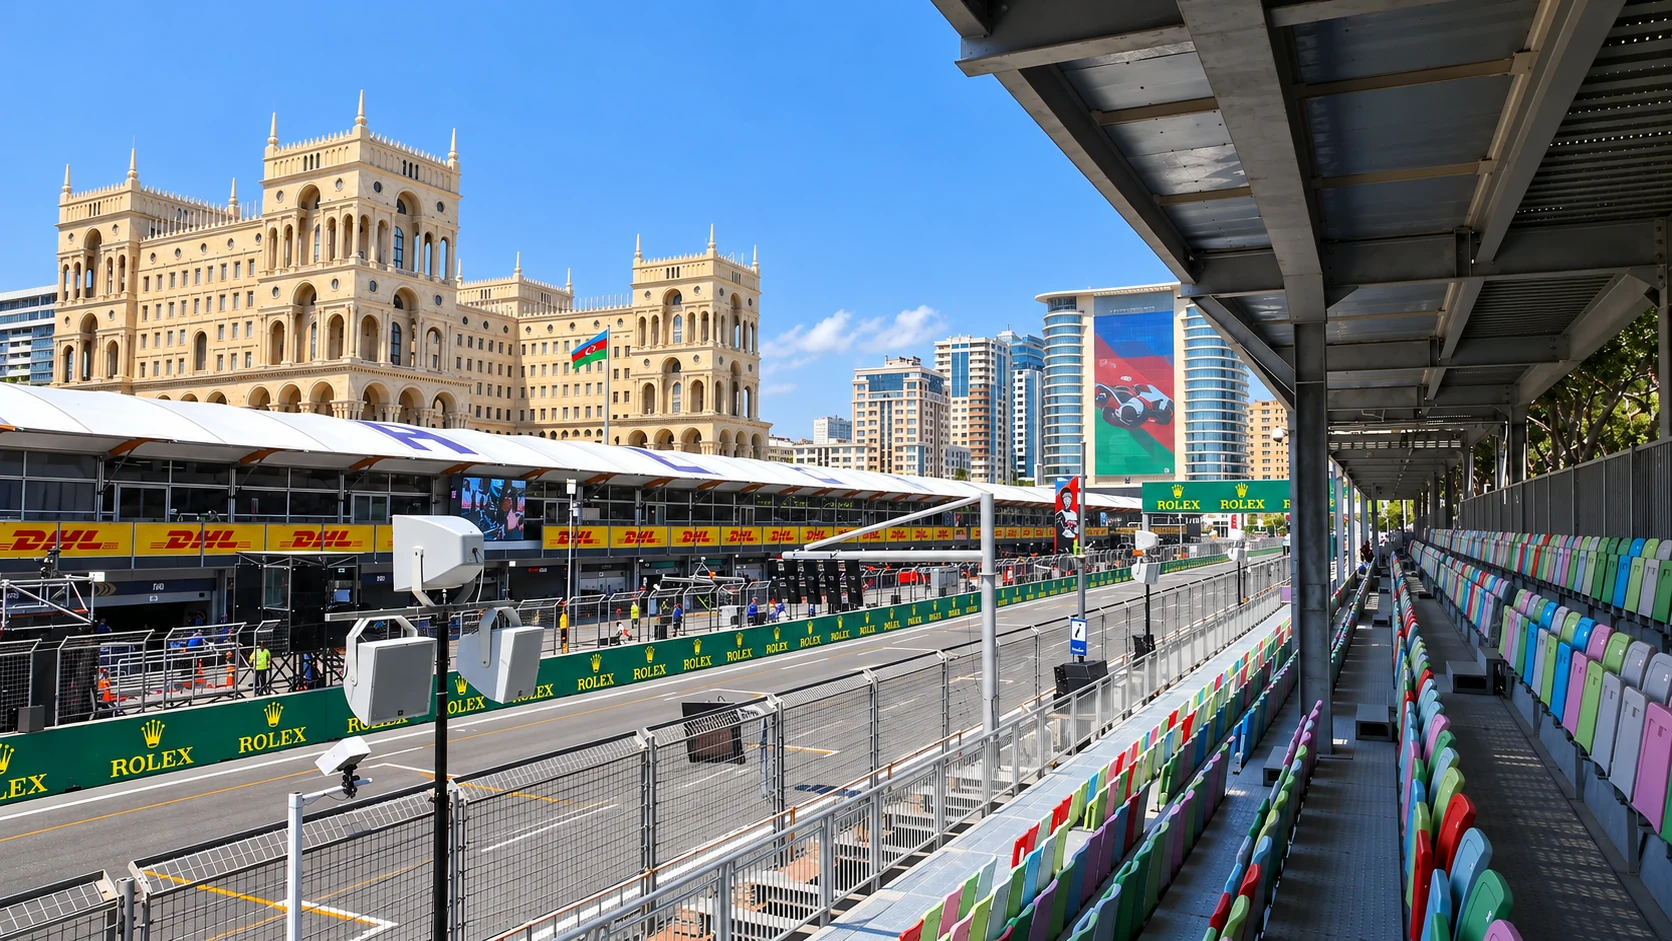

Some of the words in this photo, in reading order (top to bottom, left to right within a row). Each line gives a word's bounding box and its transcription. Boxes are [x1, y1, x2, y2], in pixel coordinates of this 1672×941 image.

[1157, 500, 1200, 510] ROLEX
[1220, 499, 1265, 509] ROLEX
[11, 529, 103, 551] DHL
[165, 530, 239, 549] DHL
[292, 530, 352, 547] DHL
[557, 530, 595, 544] DHL
[624, 530, 656, 544] DHL
[682, 530, 710, 543] DHL
[729, 530, 755, 542] DHL
[771, 530, 795, 542] DHL
[766, 641, 789, 655] ROLEX
[800, 634, 822, 648] ROLEX
[727, 648, 752, 662] ROLEX
[683, 655, 712, 671] ROLEX
[633, 663, 667, 680] ROLEX
[577, 672, 615, 691] ROLEX
[446, 695, 486, 716] OLEX
[238, 726, 307, 754] ROLEX
[110, 746, 194, 778] ROLEX
